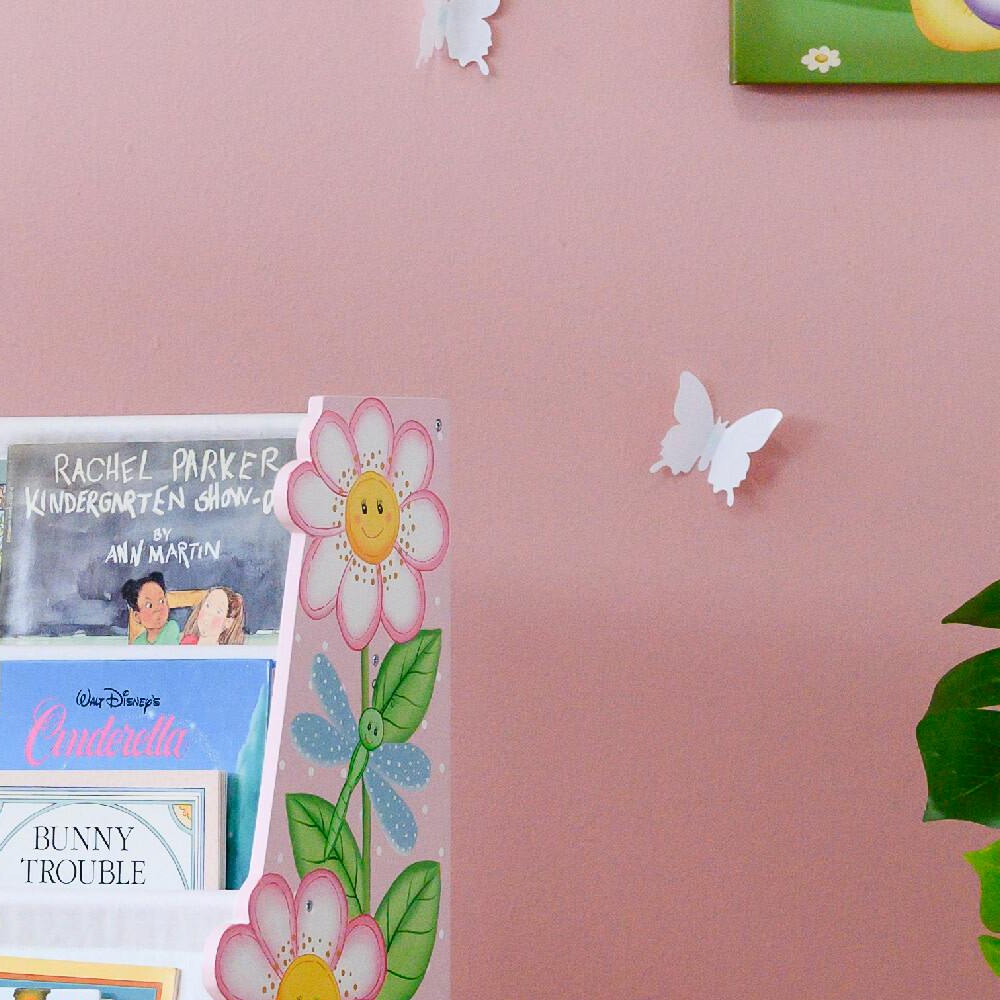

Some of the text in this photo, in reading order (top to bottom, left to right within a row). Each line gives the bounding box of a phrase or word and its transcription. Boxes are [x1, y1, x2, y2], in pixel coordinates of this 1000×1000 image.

[54, 446, 279, 485] RACHEL PARKER
[24, 485, 186, 519] KINDERGARTEN
[153, 527, 172, 542] BY
[105, 541, 221, 568] ANN MARTIN
[23, 697, 190, 767] Cinderella
[33, 826, 135, 852] BUNNY
[20, 858, 146, 886] TROUBLE
